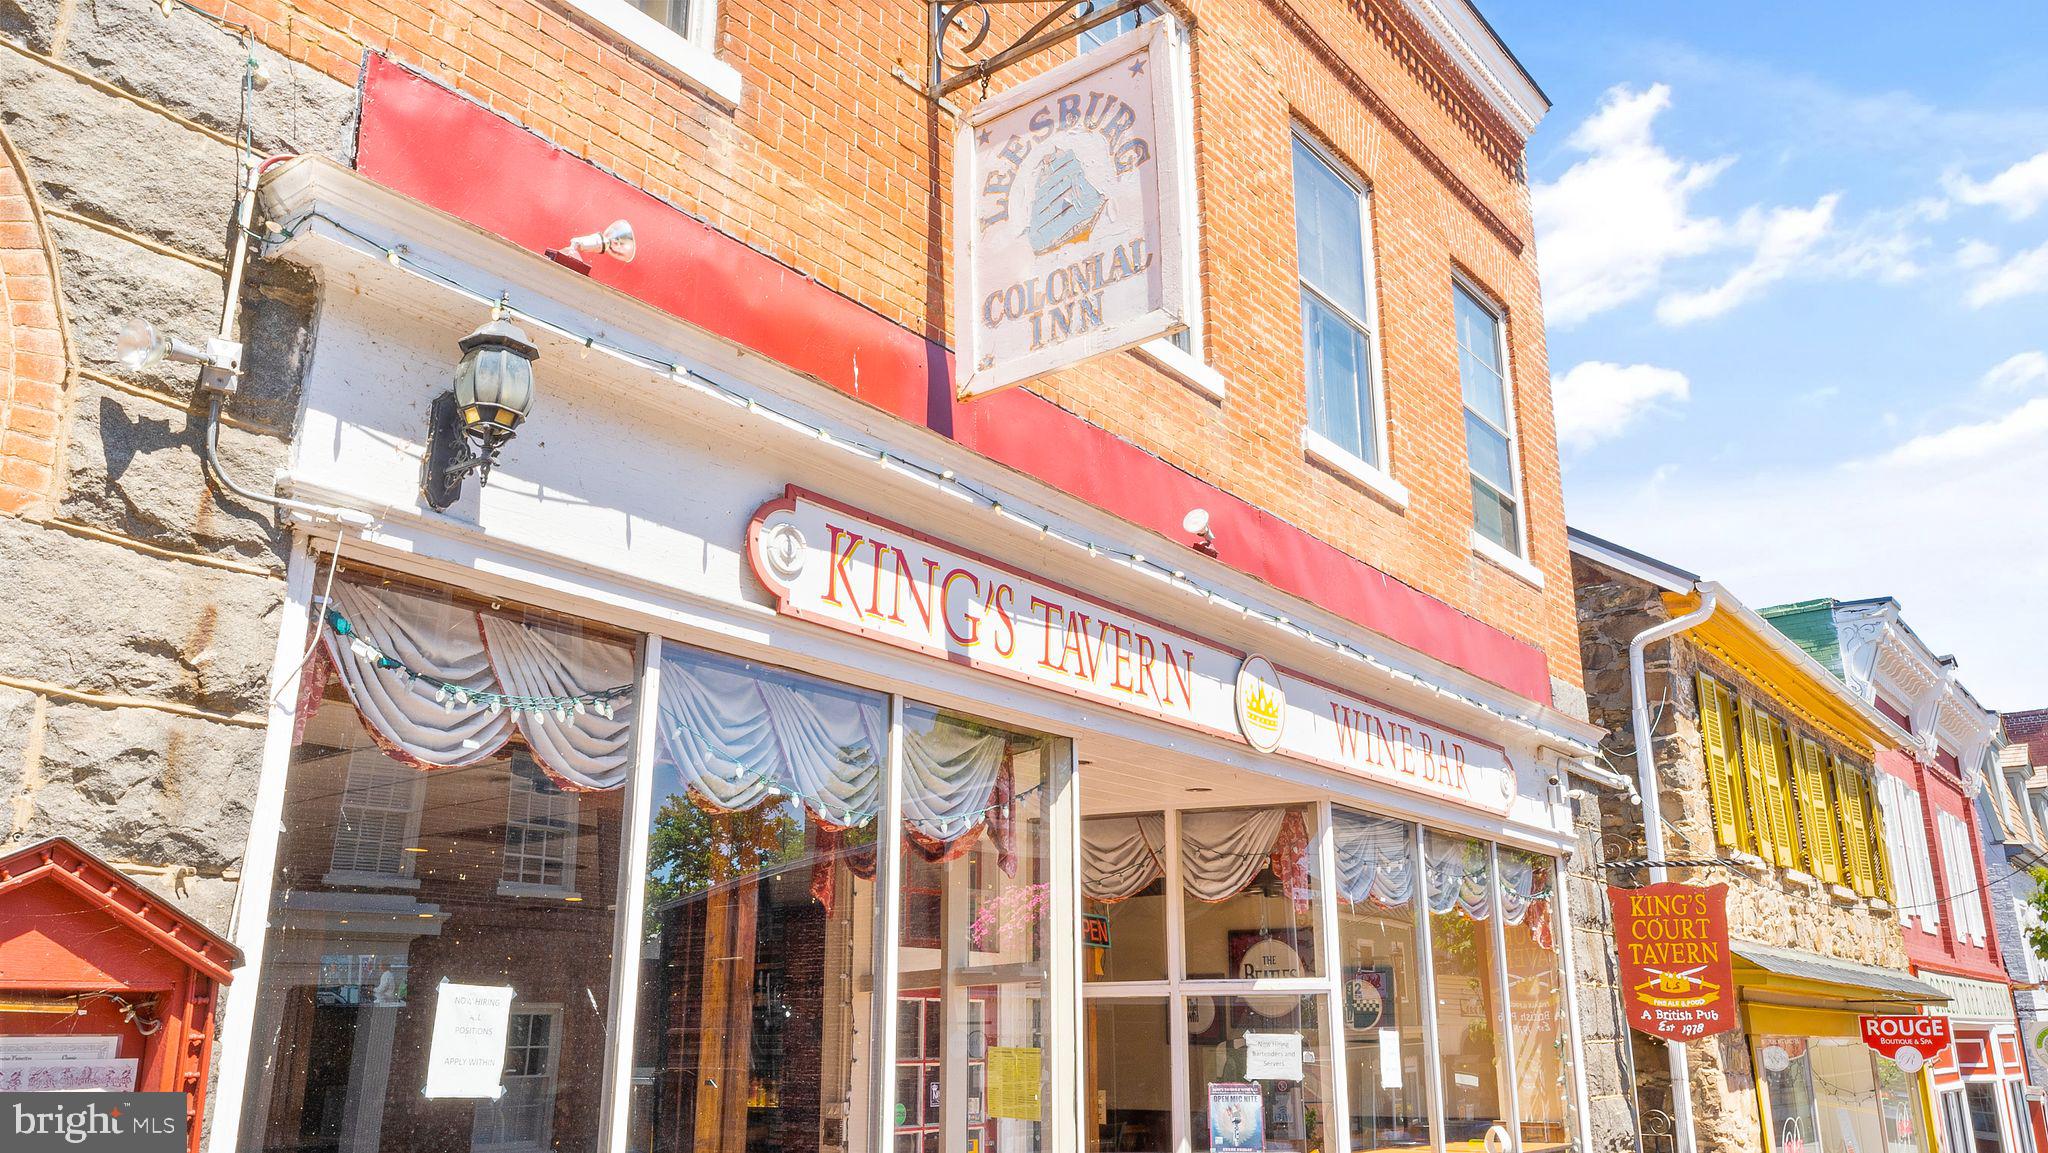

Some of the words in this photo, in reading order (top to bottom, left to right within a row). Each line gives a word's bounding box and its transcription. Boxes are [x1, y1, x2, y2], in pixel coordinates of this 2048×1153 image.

[980, 92, 1150, 233] LEESBURG
[982, 238, 1153, 329] COLONIAL
[1029, 293, 1104, 350] INN
[821, 523, 1017, 660] KING'S
[1030, 595, 1195, 713] TAVERN
[1330, 702, 1415, 777] WINE
[1418, 731, 1472, 799] BAR
[1631, 894, 1707, 917] KING'S
[1082, 919, 1108, 943] PEN
[1632, 918, 1710, 941] COURT
[1262, 956, 1276, 965] THE
[1628, 941, 1719, 965] TAVERN
[474, 999, 500, 1007] HIRING
[1640, 1010, 1652, 1020] A
[1656, 1010, 1693, 1020] British
[1696, 1010, 1718, 1020] Pub
[455, 1026, 493, 1035] POSITIONS
[1658, 1020, 1675, 1032] Est
[1682, 1023, 1704, 1036] 1978
[1866, 1019, 1944, 1036] ROUGE
[444, 1057, 466, 1065] APPLY
[469, 1058, 496, 1066] WITHIN
